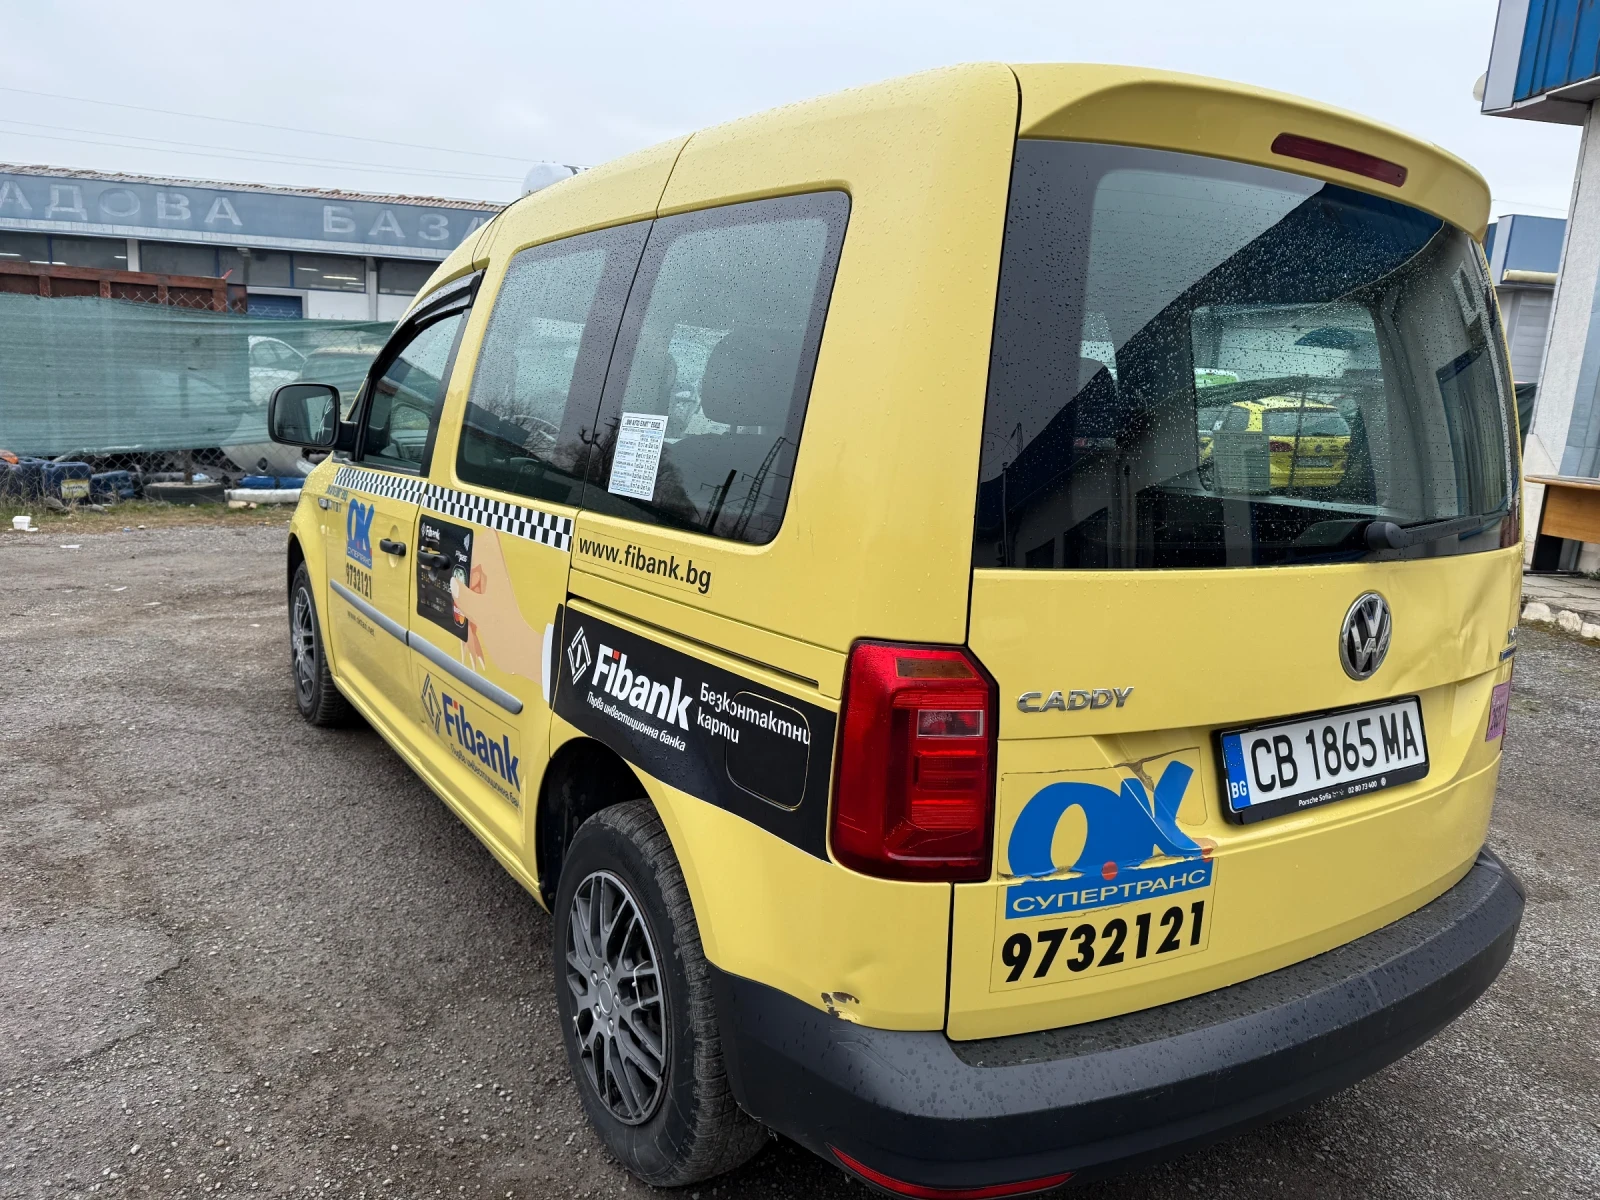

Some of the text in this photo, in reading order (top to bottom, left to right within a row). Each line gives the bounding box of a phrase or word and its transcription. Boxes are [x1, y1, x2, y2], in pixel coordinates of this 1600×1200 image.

[346, 562, 372, 600] 9732121
[578, 537, 712, 594] www.fibank.bg
[591, 643, 693, 732] Fibank
[700, 682, 811, 745] Безконтактни
[1016, 686, 1135, 713] CADDY
[442, 691, 520, 793] Fibank
[587, 691, 687, 752] Първа инвестиционна банка
[697, 706, 740, 744] карти
[1249, 710, 1420, 793] CB 1865 MA
[1230, 780, 1248, 798] BG
[1298, 796, 1319, 807] Porsche
[1319, 792, 1332, 802] Sofia
[1347, 786, 1355, 794] 02
[1012, 868, 1206, 913] СУПЕРТРАНС
[1001, 901, 1205, 983] 9732121
